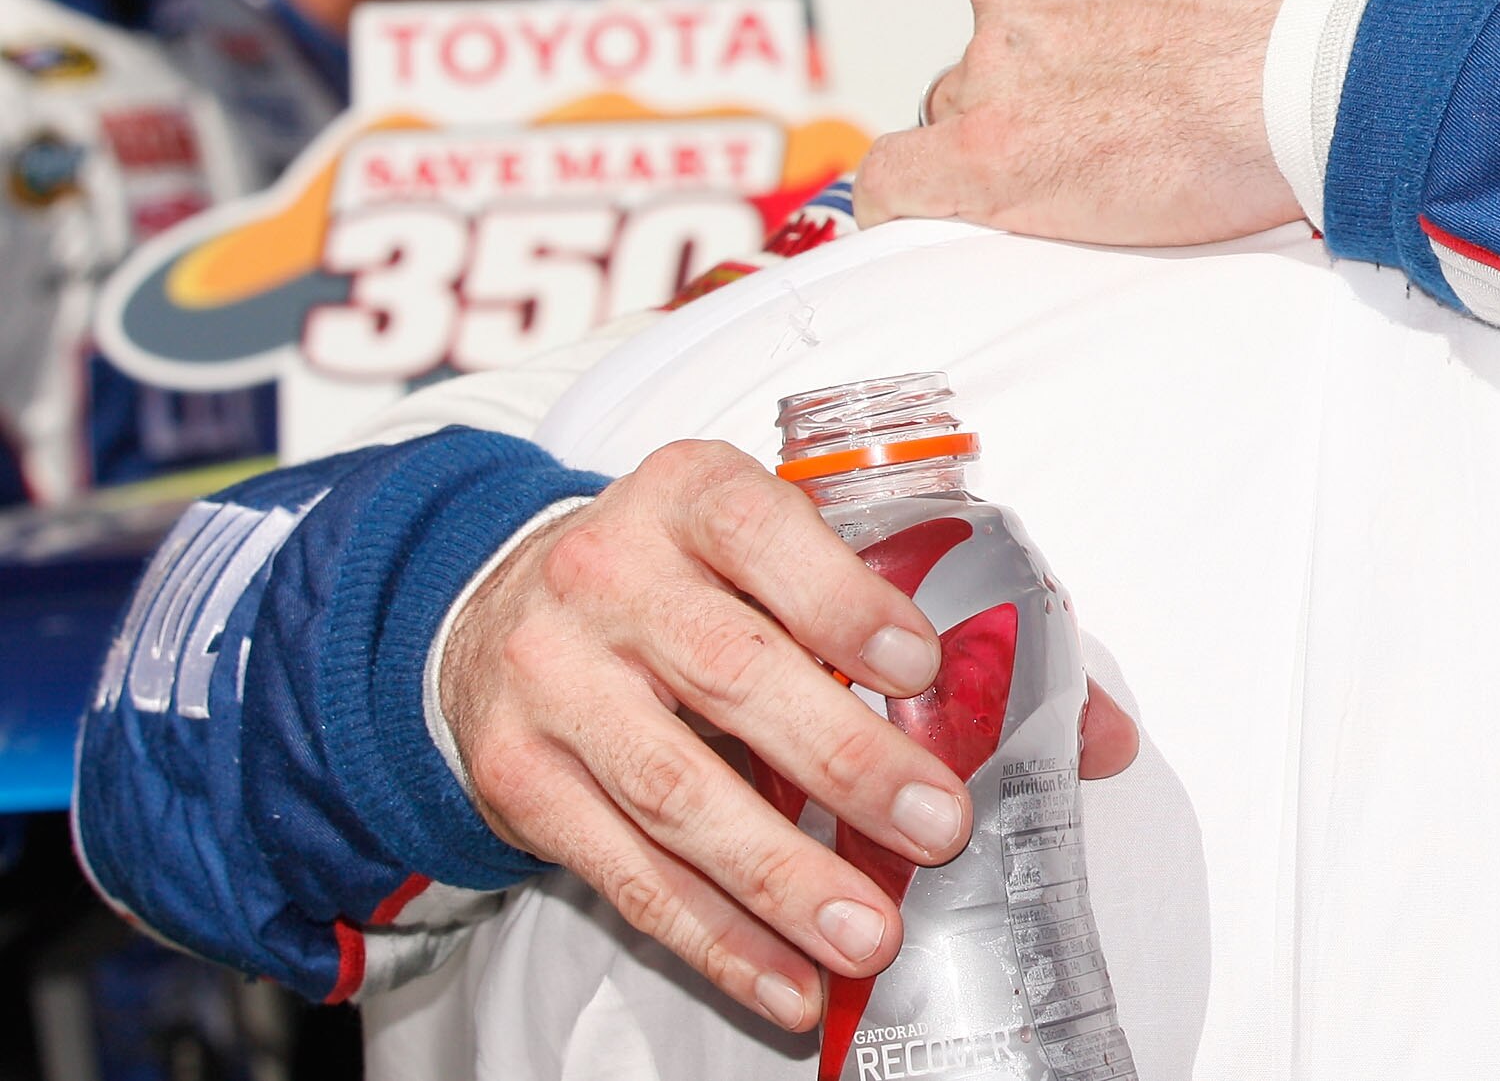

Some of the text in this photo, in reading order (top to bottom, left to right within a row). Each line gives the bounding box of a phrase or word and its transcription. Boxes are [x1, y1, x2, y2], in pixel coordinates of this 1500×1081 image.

[382, 11, 782, 85] TOYOTA
[363, 136, 755, 191] SAVE MART
[1002, 763, 1014, 776] NO
[1002, 776, 1056, 799] Nutrition
[1007, 870, 1042, 887] Calories
[853, 1021, 931, 1046] GATORAD
